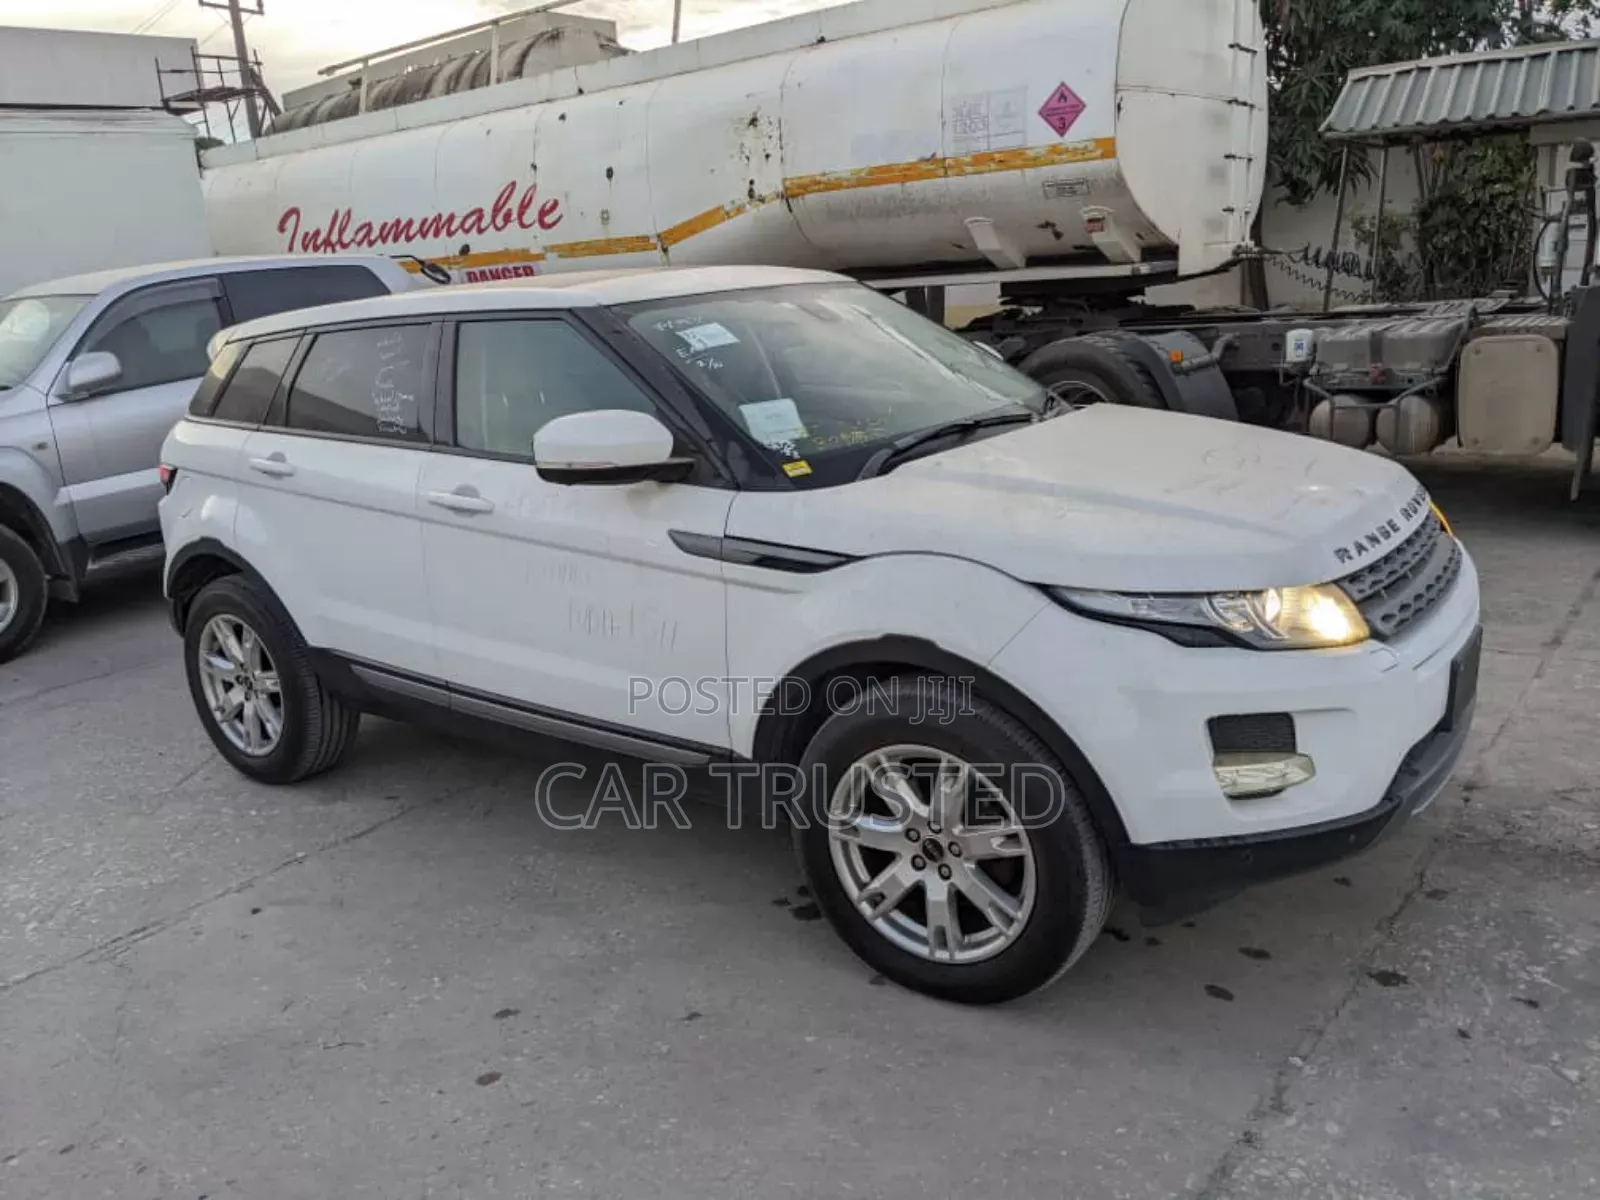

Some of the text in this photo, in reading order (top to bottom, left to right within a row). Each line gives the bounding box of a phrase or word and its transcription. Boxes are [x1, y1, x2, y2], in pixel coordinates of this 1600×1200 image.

[1058, 116, 1066, 130] 3
[277, 180, 563, 254] Inflammable
[465, 264, 535, 283] DANGER
[1333, 518, 1401, 564] RANGE
